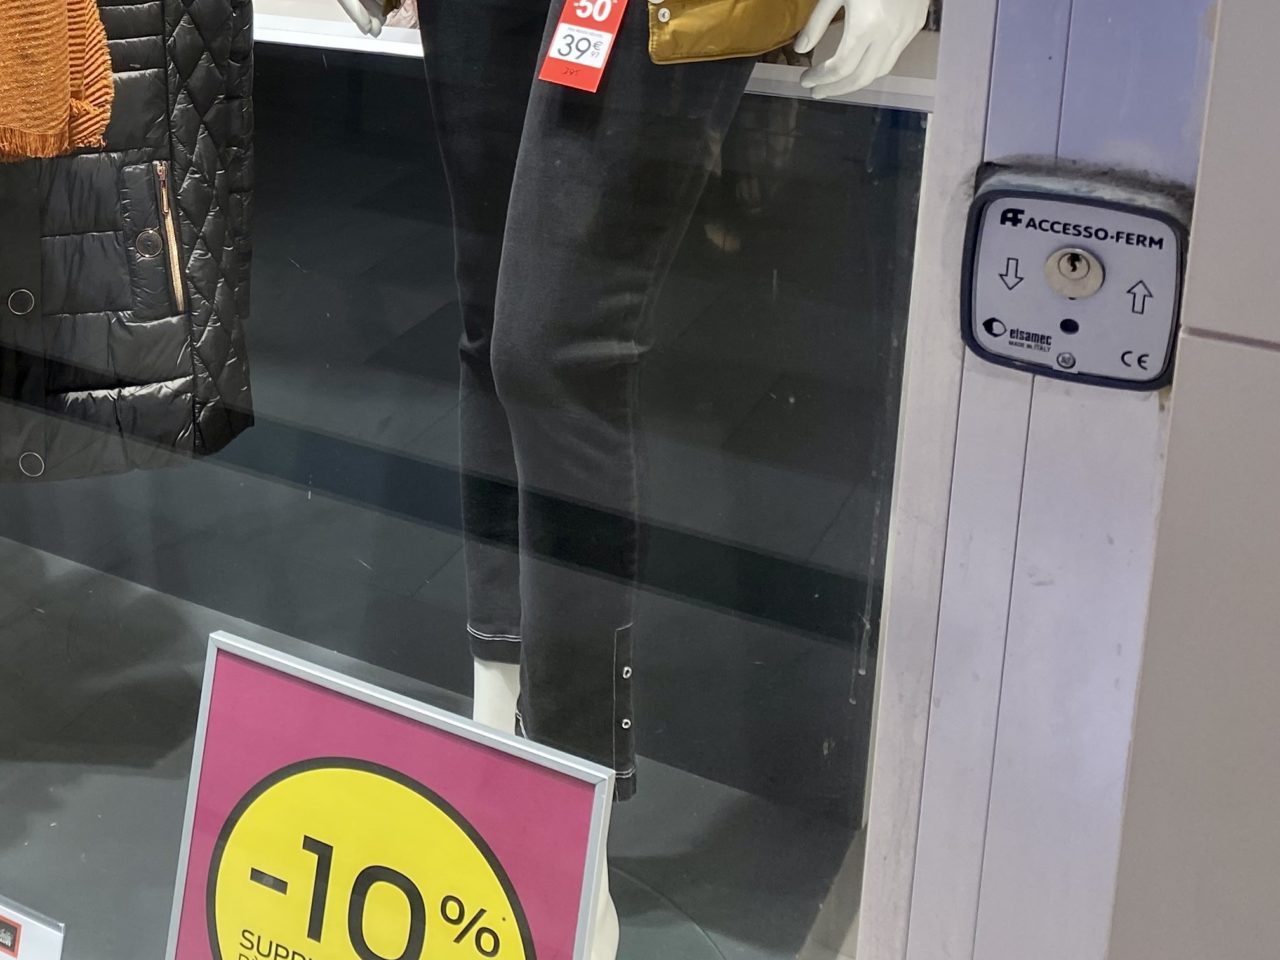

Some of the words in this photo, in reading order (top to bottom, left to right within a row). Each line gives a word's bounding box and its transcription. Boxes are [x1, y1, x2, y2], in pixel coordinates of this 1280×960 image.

[1025, 217, 1164, 250] ACCESSO-FERM
[1009, 328, 1052, 346] elsamec
[1034, 343, 1051, 352] ITALY
[249, 834, 501, 960] -10%
